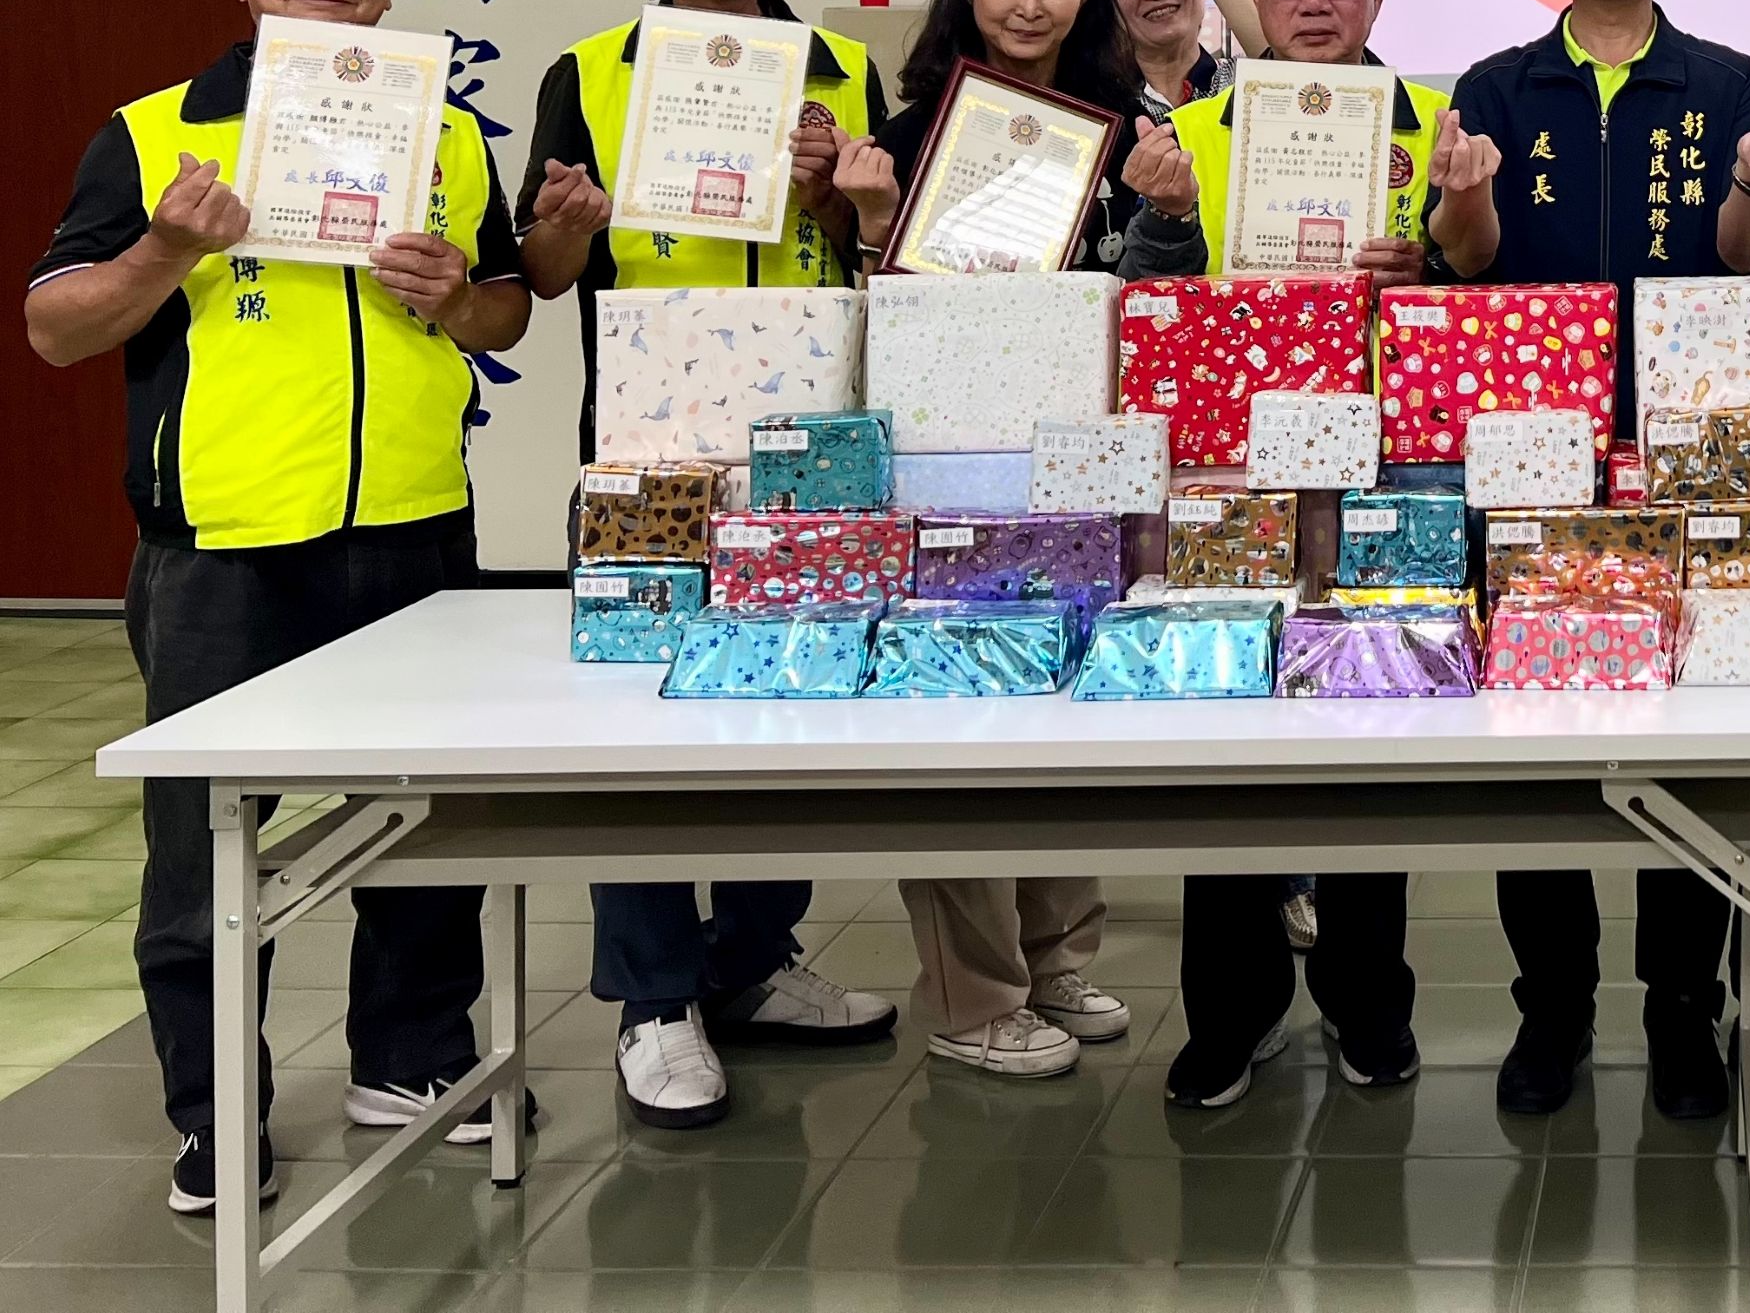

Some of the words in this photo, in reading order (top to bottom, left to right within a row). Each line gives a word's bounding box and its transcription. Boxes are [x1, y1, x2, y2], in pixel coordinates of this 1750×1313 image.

[1528, 130, 1557, 206] 處長
[1647, 128, 1672, 262] 榮民服務處
[1679, 110, 1706, 206] 彰化縣
